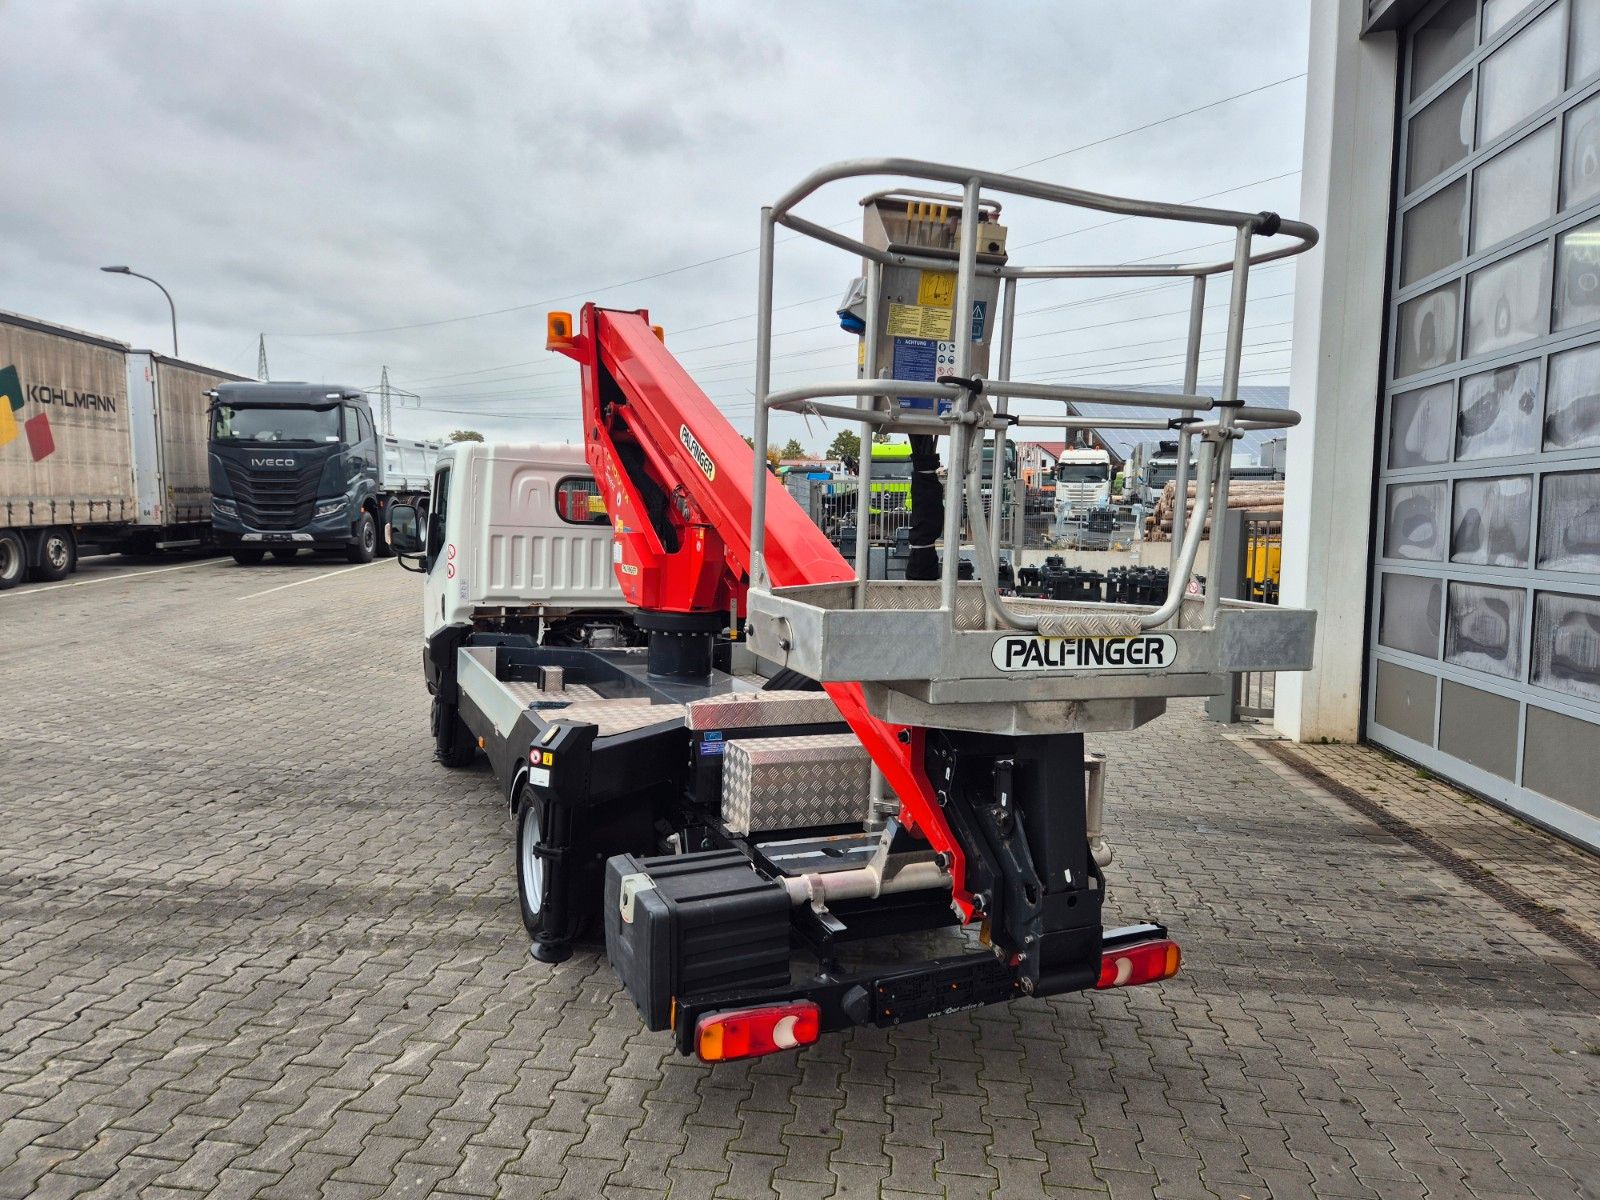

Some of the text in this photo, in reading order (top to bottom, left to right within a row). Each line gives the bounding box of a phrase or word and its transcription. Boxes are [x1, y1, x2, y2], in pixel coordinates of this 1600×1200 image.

[905, 339, 927, 347] ACHTUNG
[26, 383, 116, 413] KOHLMANN
[251, 458, 295, 467] IVECO
[682, 426, 714, 479] PALFINGER
[1006, 637, 1164, 668] PALFINGER
